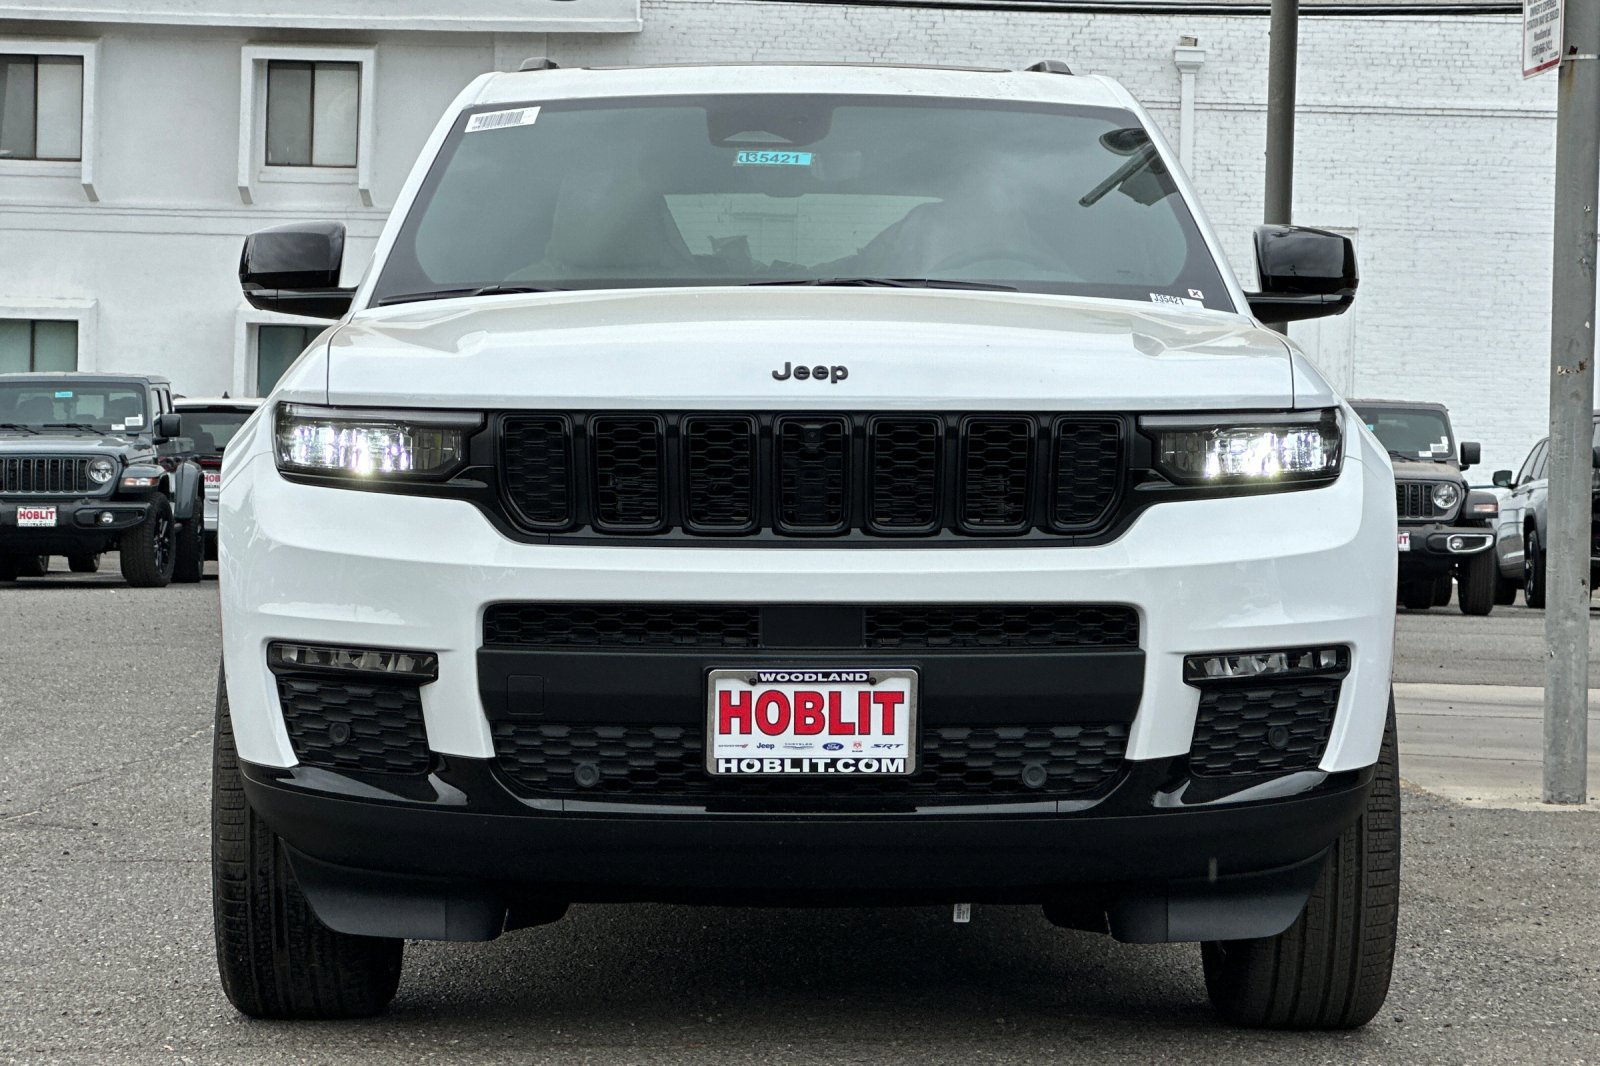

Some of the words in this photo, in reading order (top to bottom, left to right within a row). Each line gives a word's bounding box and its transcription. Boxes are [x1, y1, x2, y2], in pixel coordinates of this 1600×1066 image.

[738, 152, 800, 164] J35421
[1154, 294, 1184, 305] J35421
[771, 361, 849, 384] Jeep
[19, 510, 55, 519] HOBLIT
[759, 672, 868, 682] WOODLAND
[718, 689, 905, 736] HOBLIT
[756, 742, 775, 750] Jeep
[718, 758, 905, 773] HOBLIT.COM
